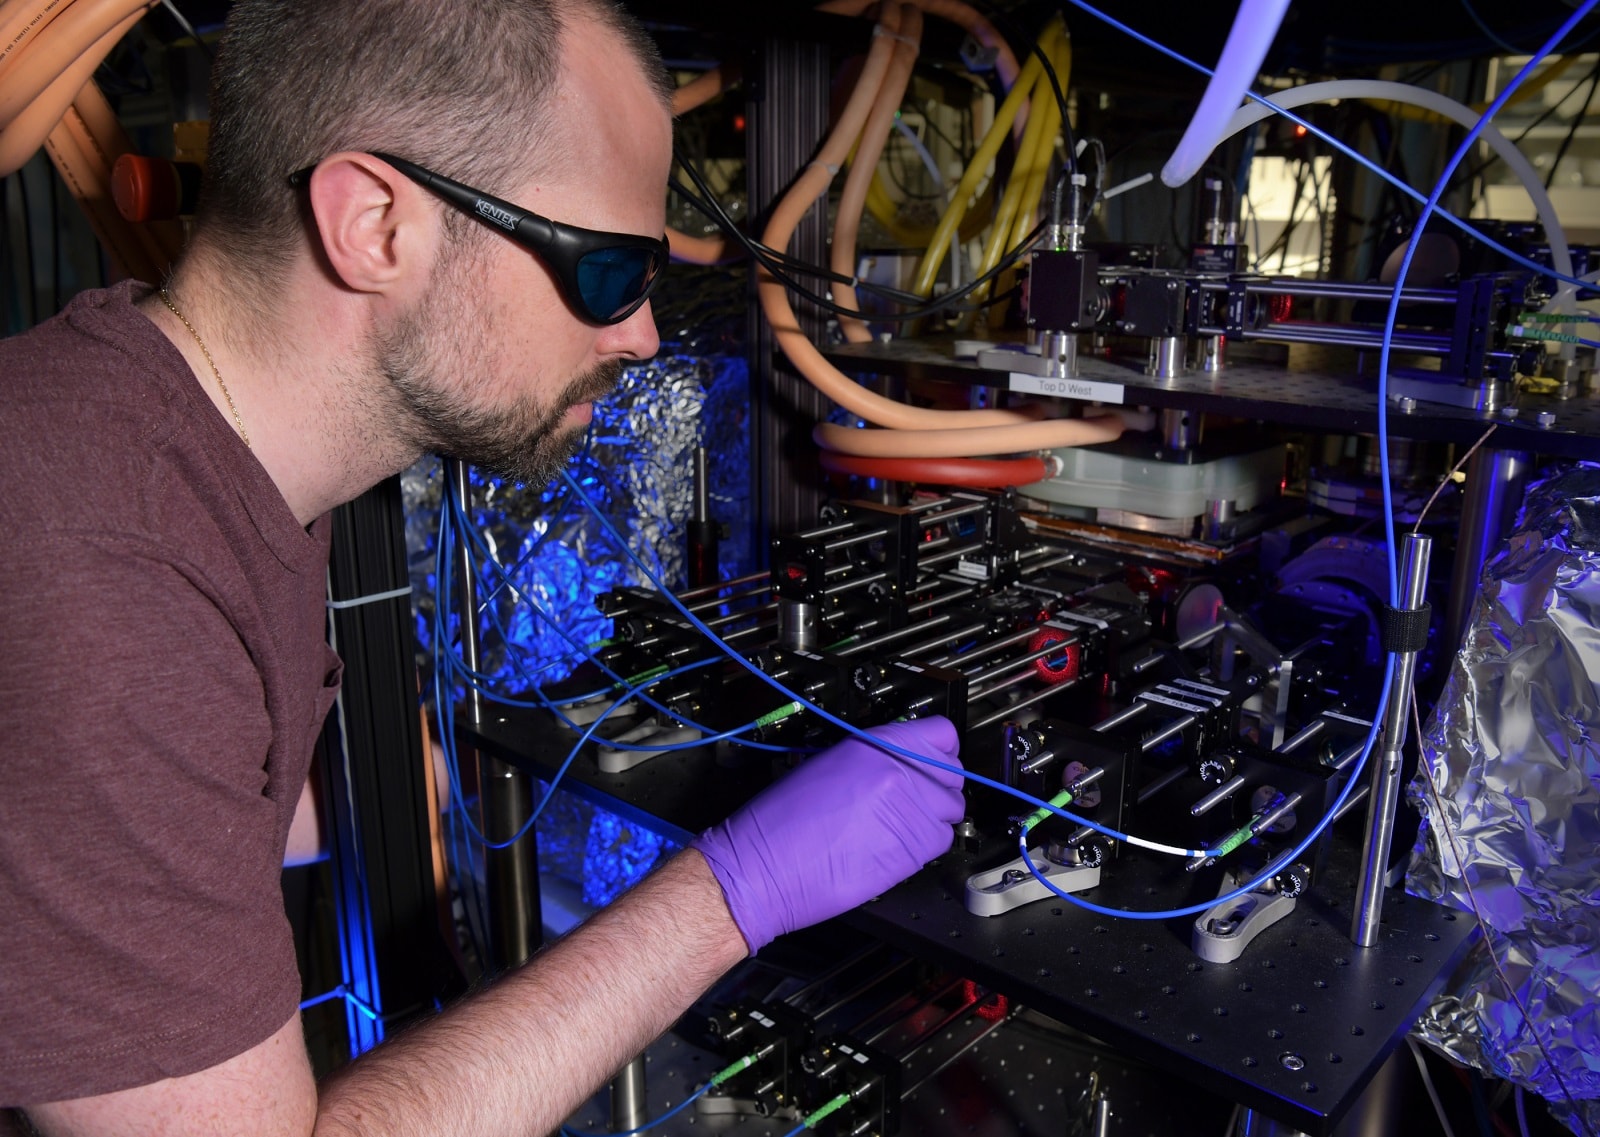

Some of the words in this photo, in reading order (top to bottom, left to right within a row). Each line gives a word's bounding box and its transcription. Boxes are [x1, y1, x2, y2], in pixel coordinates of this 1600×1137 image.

[476, 199, 516, 229] KENTEK
[1039, 380, 1056, 392] Top
[1058, 382, 1066, 393] D
[1068, 383, 1092, 396] West
[1199, 760, 1222, 782] THORLABS
[1083, 845, 1102, 868] THORLABS
[1280, 873, 1301, 898] THORLABS
